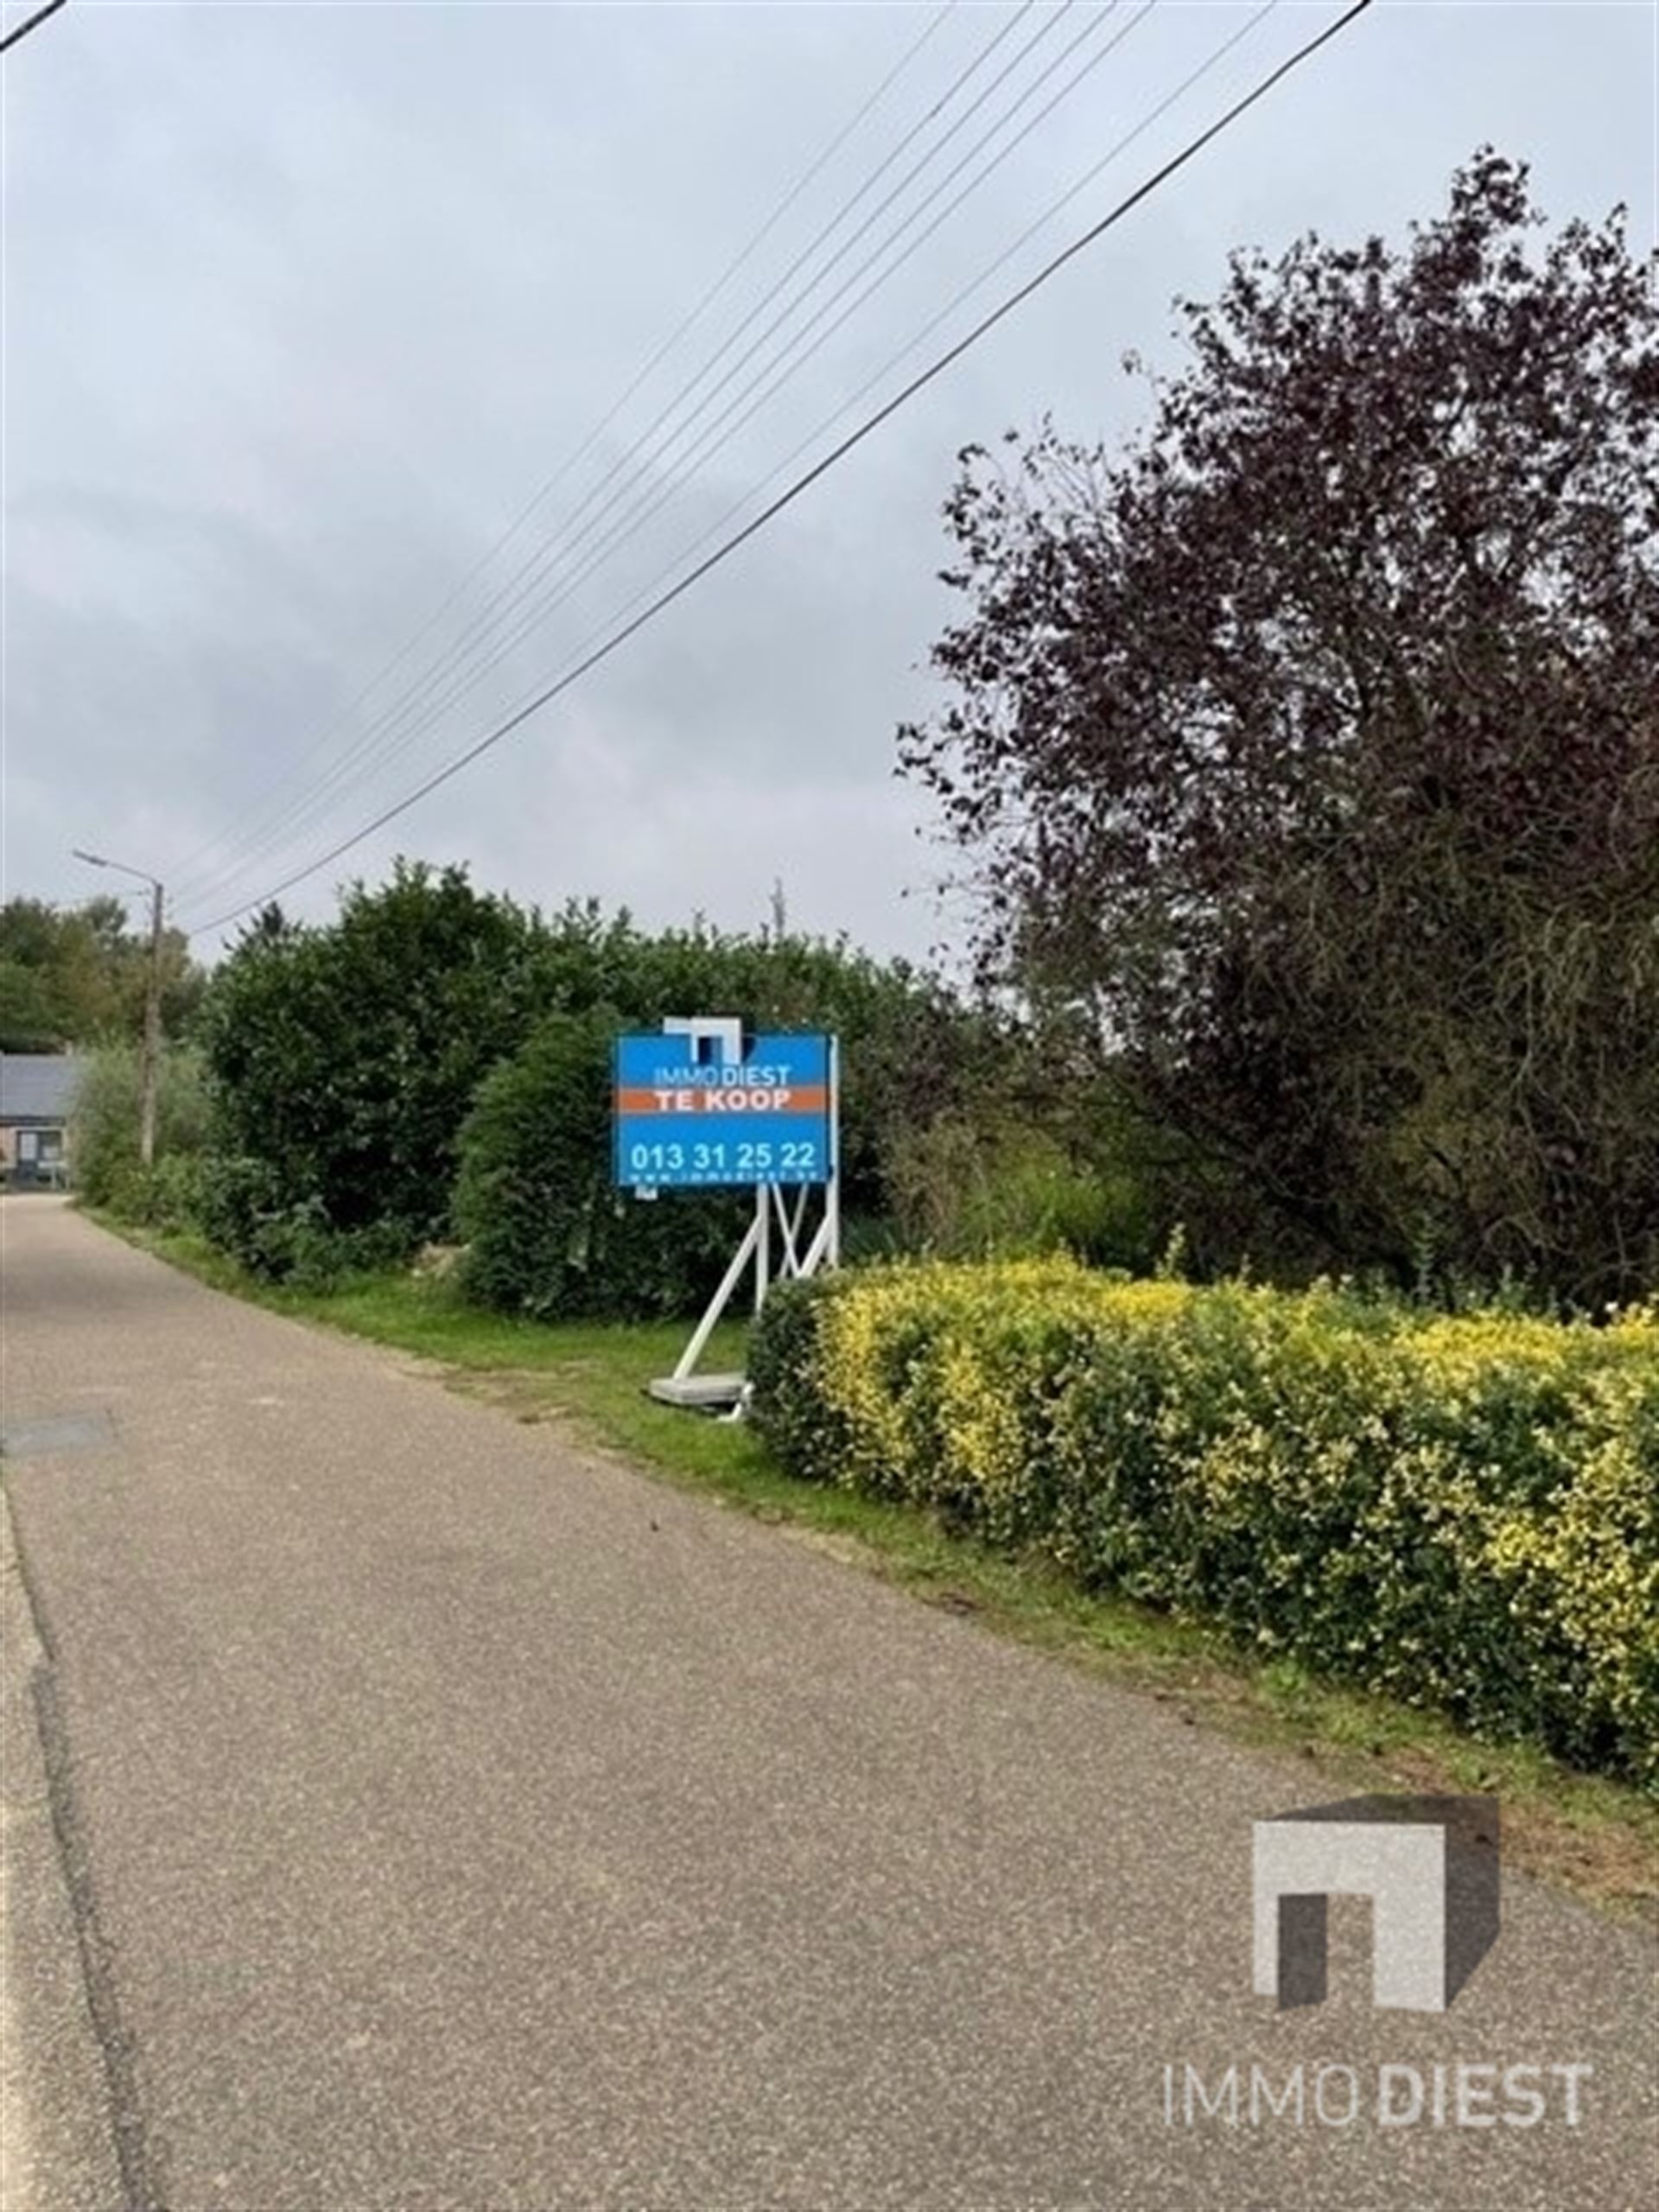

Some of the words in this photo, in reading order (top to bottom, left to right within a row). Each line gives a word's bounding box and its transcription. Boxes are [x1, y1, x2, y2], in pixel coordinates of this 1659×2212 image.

[654, 1090, 693, 1111] TE
[704, 1090, 791, 1111] KOOP
[631, 1143, 684, 1170] 013
[693, 1144, 726, 1169] 31
[736, 1143, 772, 1168] 25
[780, 1142, 815, 1166] 22
